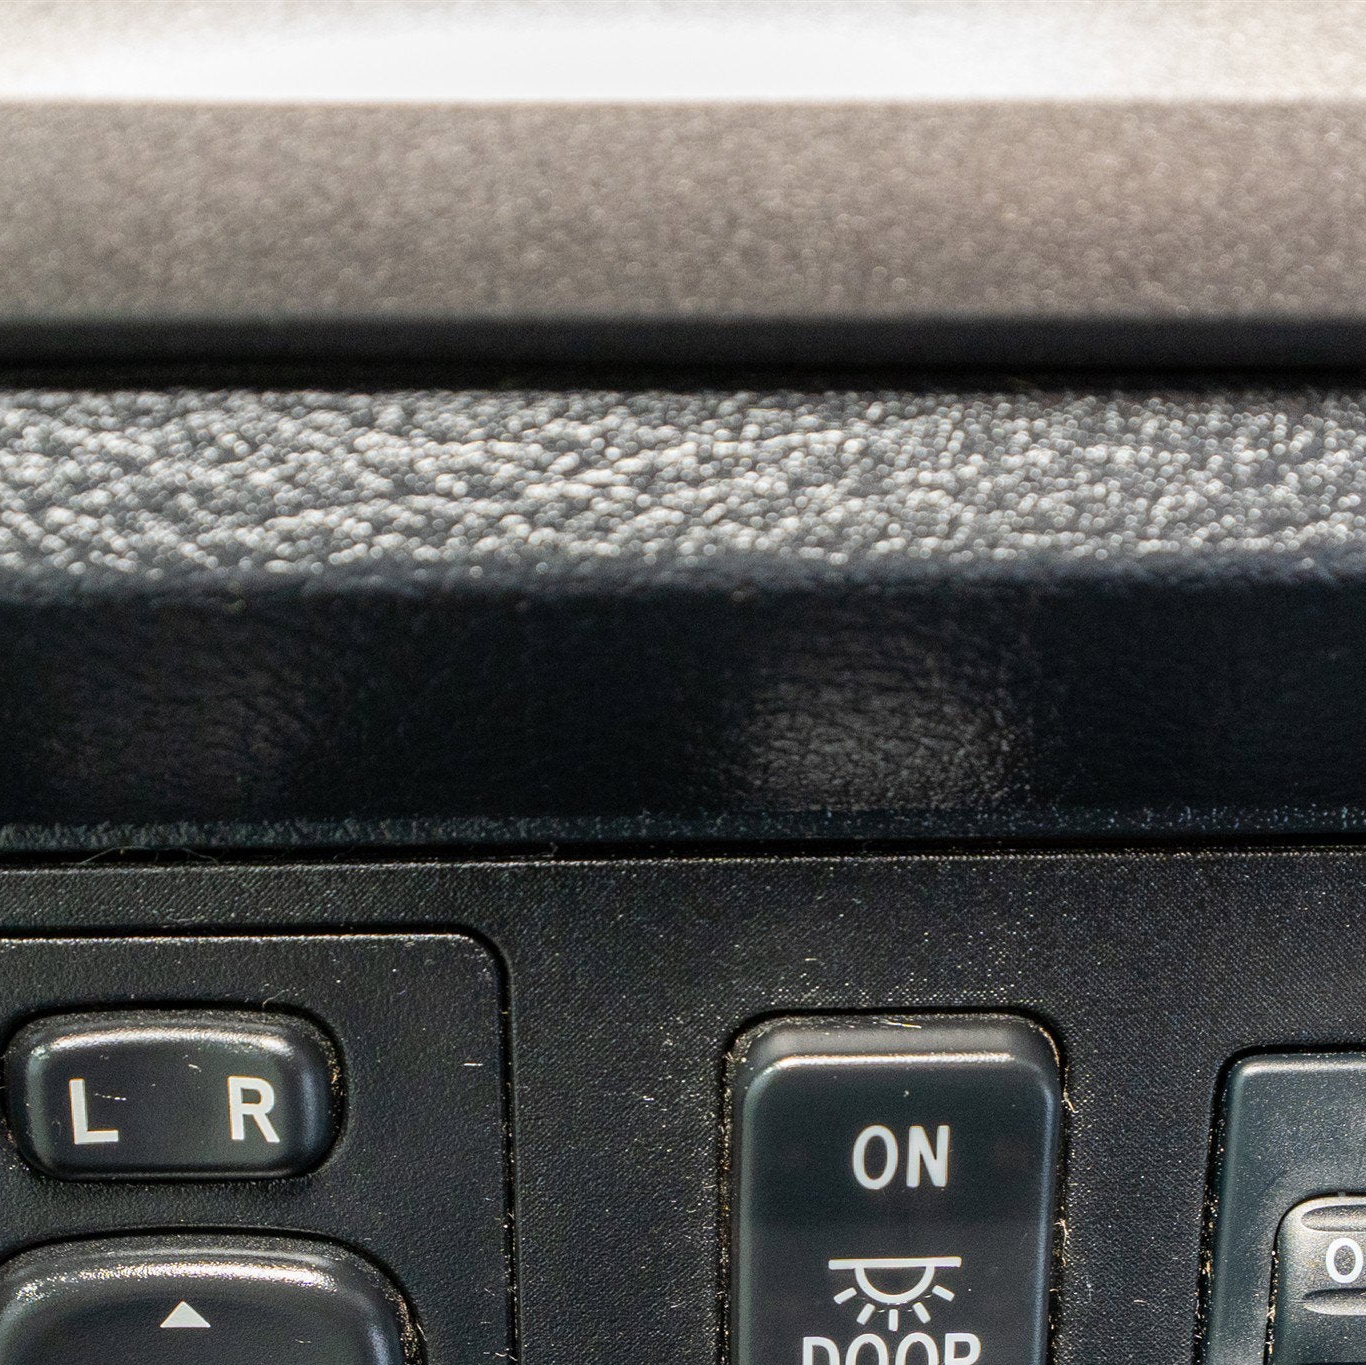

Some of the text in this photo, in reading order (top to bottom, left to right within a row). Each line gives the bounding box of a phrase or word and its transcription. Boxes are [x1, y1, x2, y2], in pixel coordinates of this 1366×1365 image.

[68, 1075, 281, 1144] L R
[851, 1124, 951, 1191] ON
